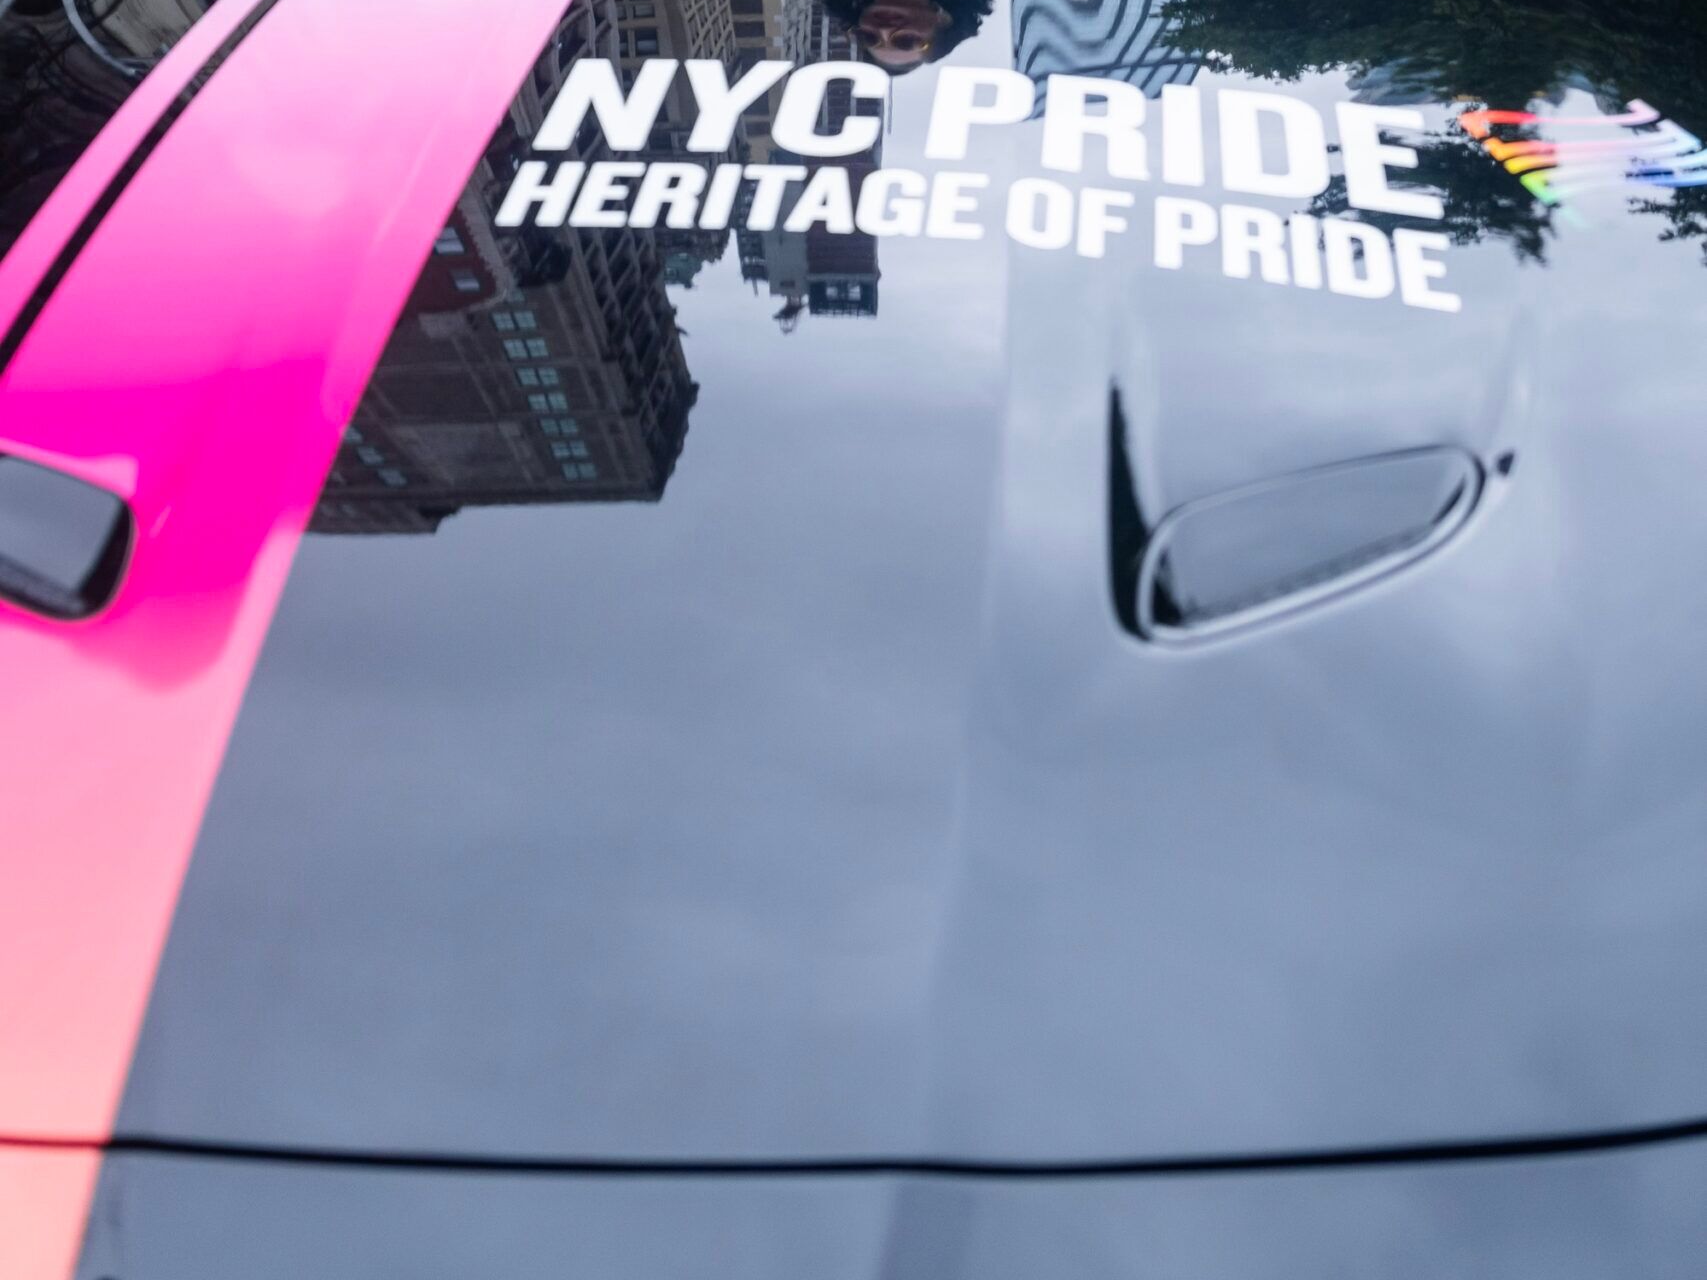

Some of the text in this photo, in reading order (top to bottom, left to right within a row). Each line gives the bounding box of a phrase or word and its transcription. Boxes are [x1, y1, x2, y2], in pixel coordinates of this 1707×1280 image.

[532, 58, 1444, 221] NYC PRIDE
[495, 161, 1461, 314] HERITAGE OF PRIDE
